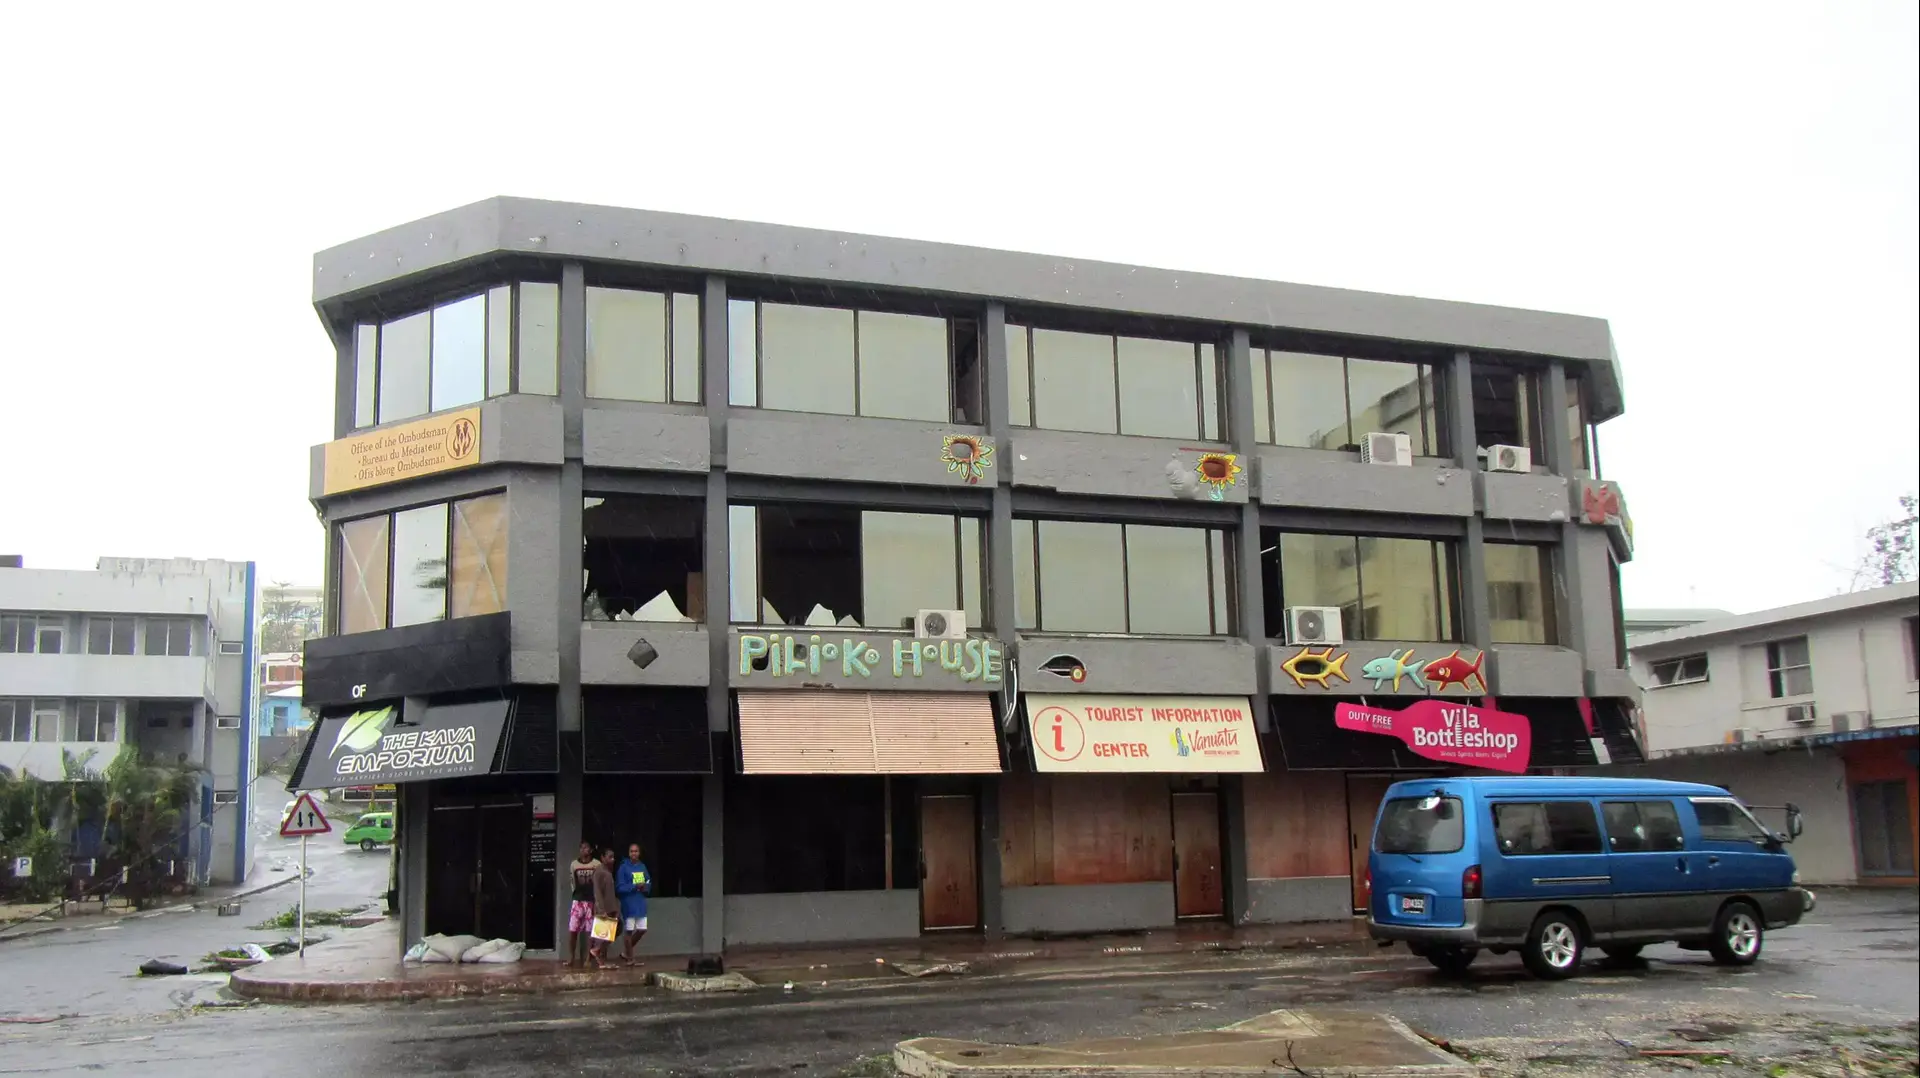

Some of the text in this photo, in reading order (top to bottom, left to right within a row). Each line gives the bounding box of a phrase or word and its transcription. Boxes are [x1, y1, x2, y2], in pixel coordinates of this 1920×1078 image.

[350, 427, 447, 455] Office of the Ombudsman
[358, 455, 445, 480] Ofis blong Ombudsman
[361, 452, 388, 466] Bureau
[390, 449, 400, 460] du
[352, 684, 367, 698] OF
[1085, 706, 1243, 723] TOURIST INFORMATION
[1348, 710, 1392, 725] DUTY FREE
[382, 725, 476, 750] THE KAVA
[1187, 727, 1239, 752] Vanuatu
[1413, 727, 1518, 753] Bottleshop
[336, 743, 474, 774] EMPORIUM
[1093, 743, 1150, 758] CENTER
[20, 858, 30, 869] P
